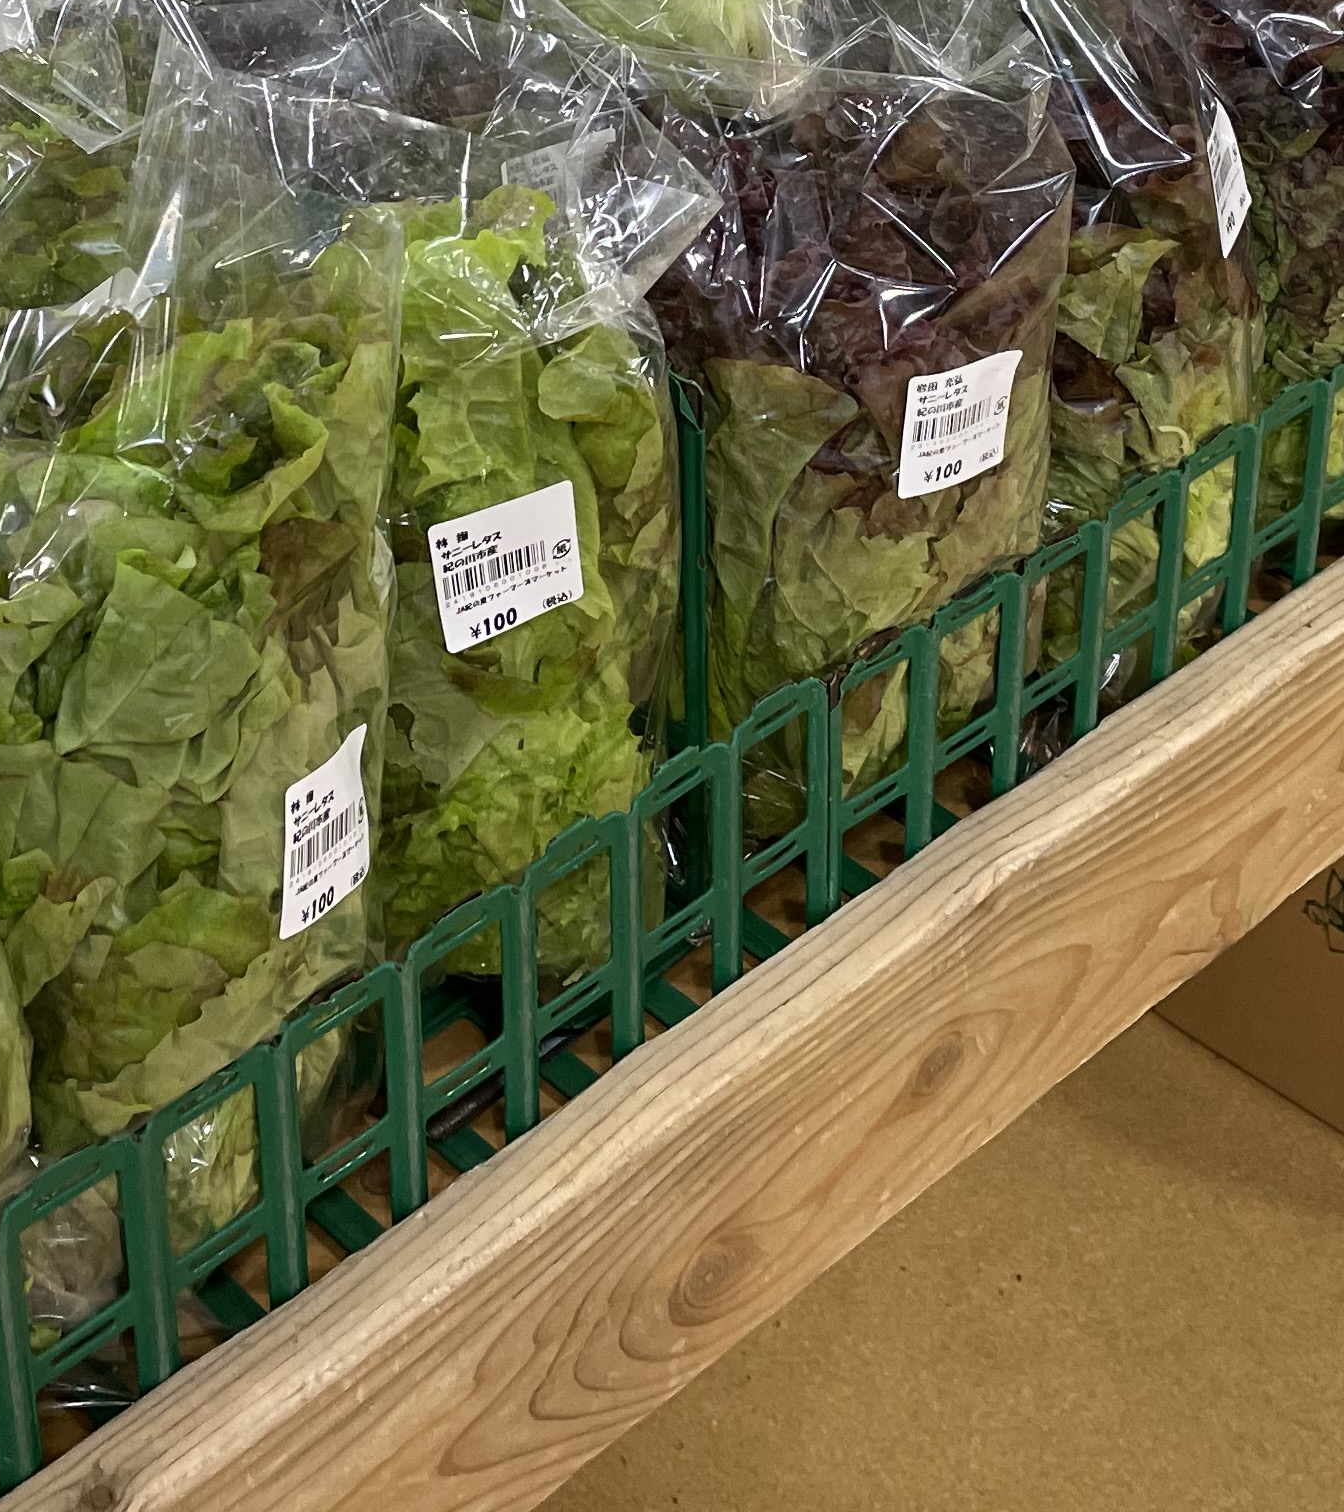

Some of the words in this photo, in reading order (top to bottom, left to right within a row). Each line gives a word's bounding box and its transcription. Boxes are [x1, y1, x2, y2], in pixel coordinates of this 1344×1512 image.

[918, 384, 968, 405] サニーレタス
[923, 459, 963, 483] ¥100
[440, 531, 503, 560] サニーレタス
[443, 544, 499, 574] 紀の川市産
[469, 607, 518, 640] ¥100
[293, 790, 335, 828] サニーレタス
[301, 885, 335, 924] ¥100
